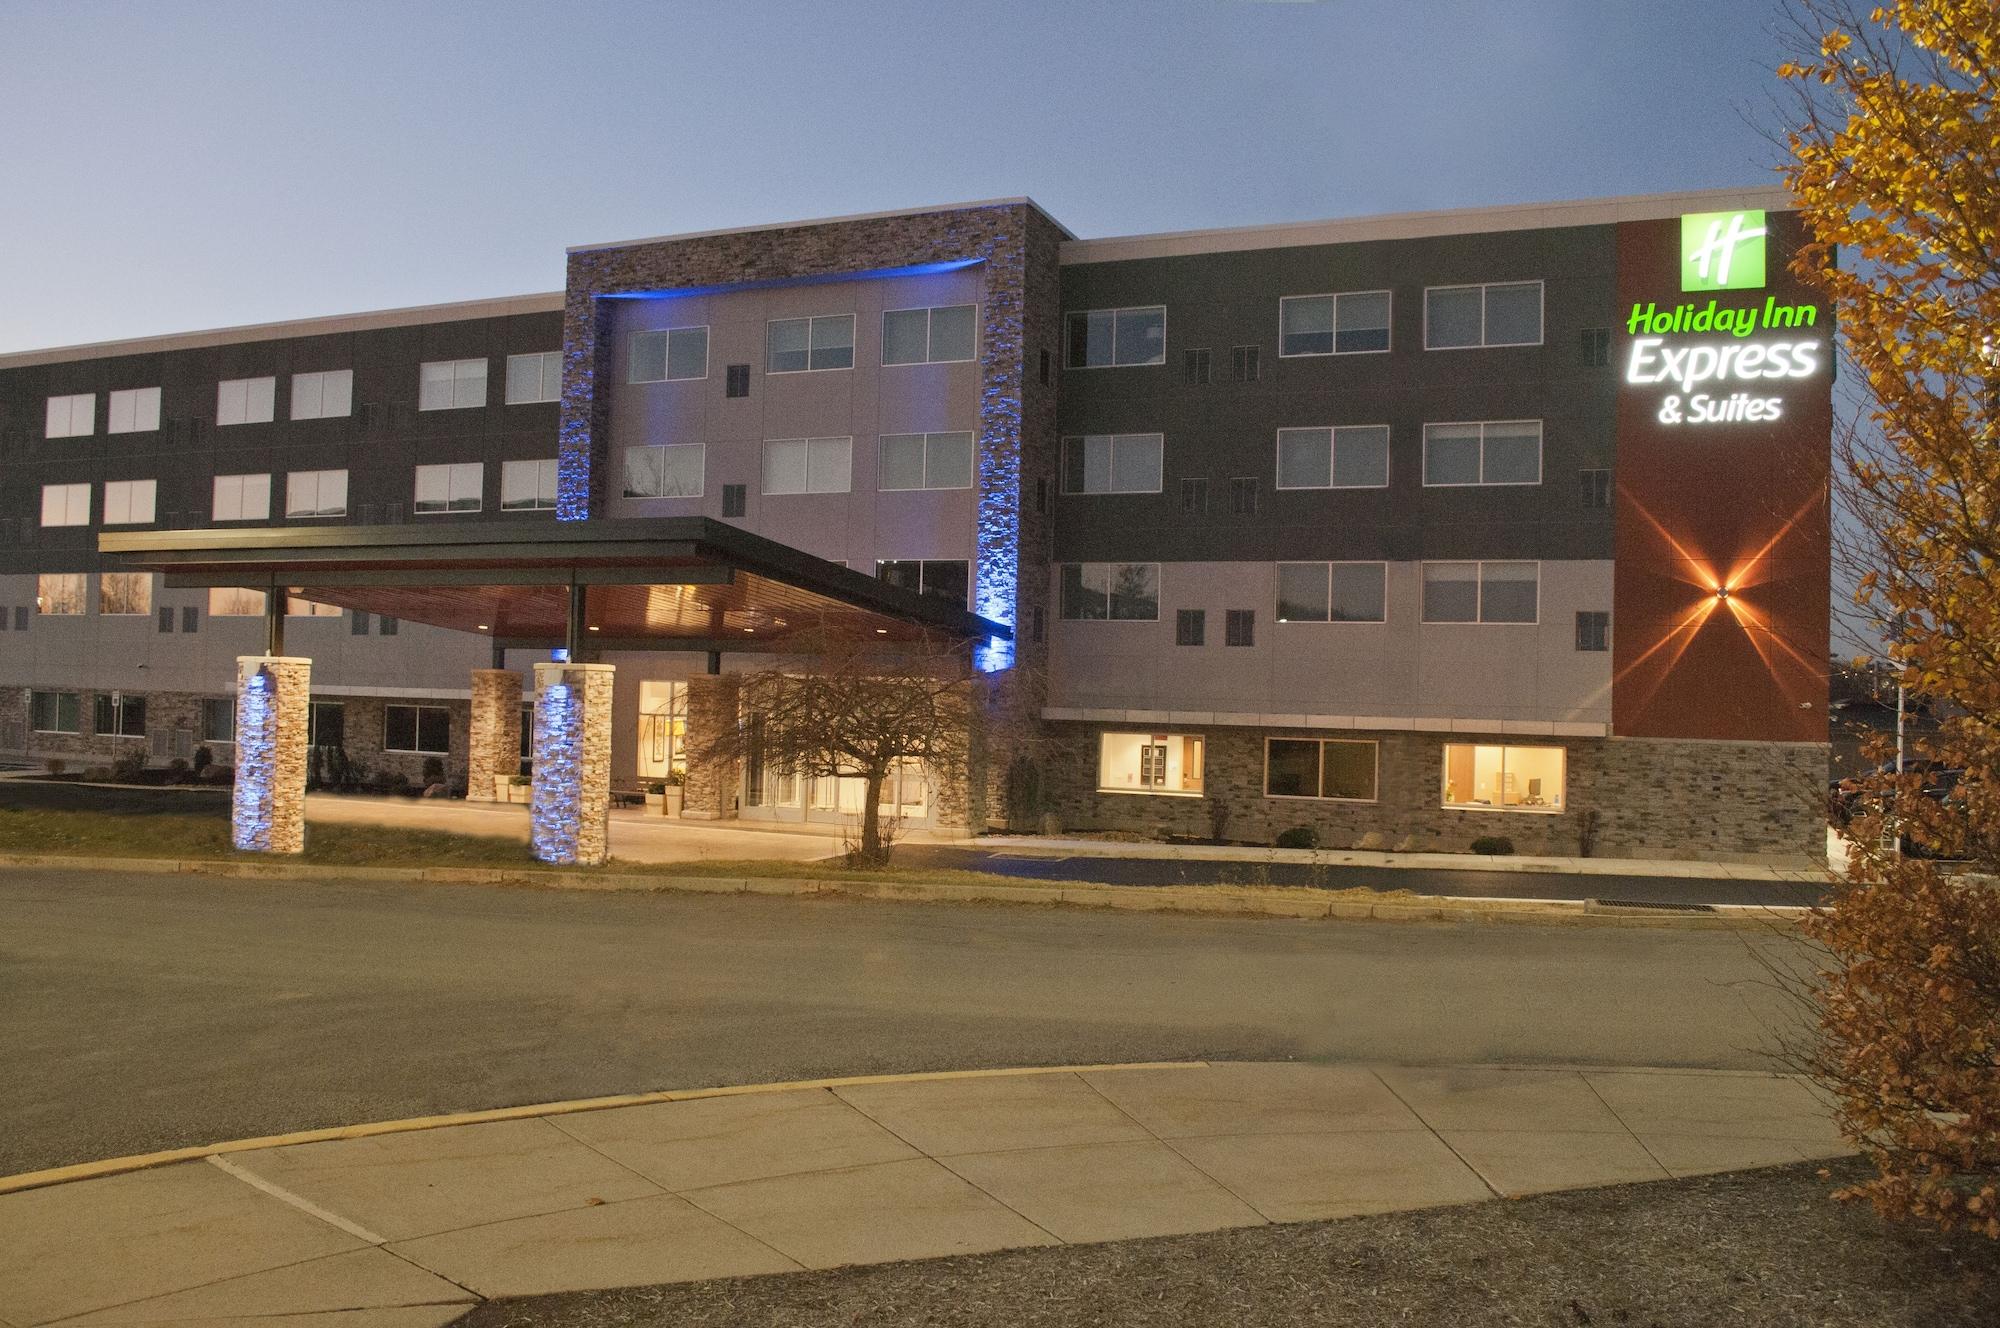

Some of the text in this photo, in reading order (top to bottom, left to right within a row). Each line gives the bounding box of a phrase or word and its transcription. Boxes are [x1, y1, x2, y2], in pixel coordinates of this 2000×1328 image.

[1627, 297, 1816, 337] Holiday Inn
[1626, 338, 1818, 393] Express
[1658, 393, 1782, 423] & Suites
